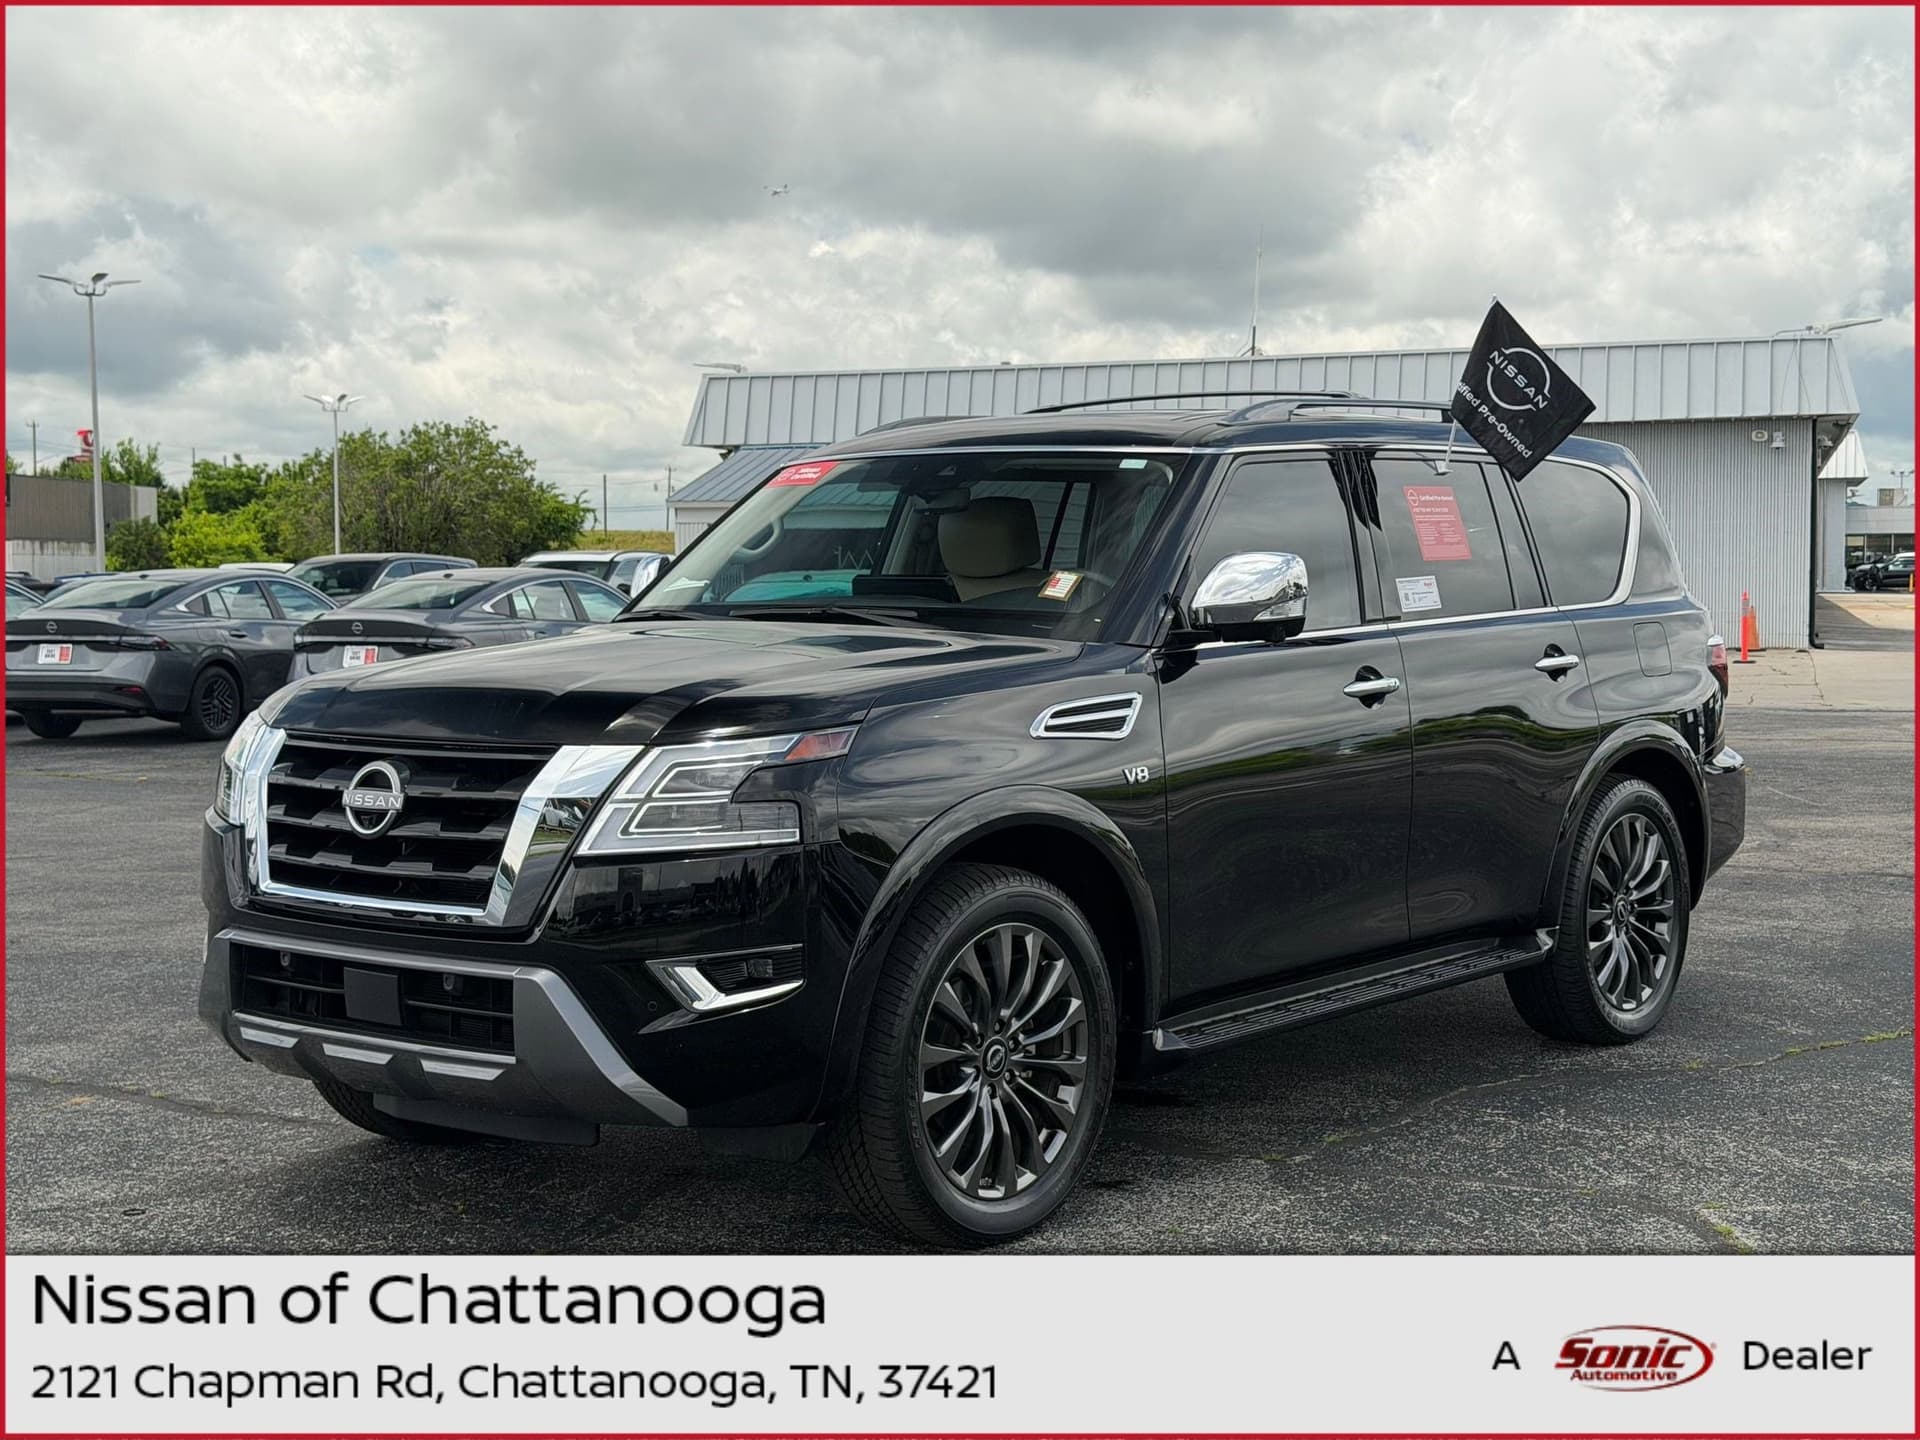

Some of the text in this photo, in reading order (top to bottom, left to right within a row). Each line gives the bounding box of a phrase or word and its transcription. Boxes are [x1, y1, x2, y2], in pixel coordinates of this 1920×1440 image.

[1489, 350, 1549, 409] NISSAN
[1478, 404, 1533, 458] Pre-Owned
[1123, 766, 1150, 785] V8
[342, 792, 402, 809] NISSAN
